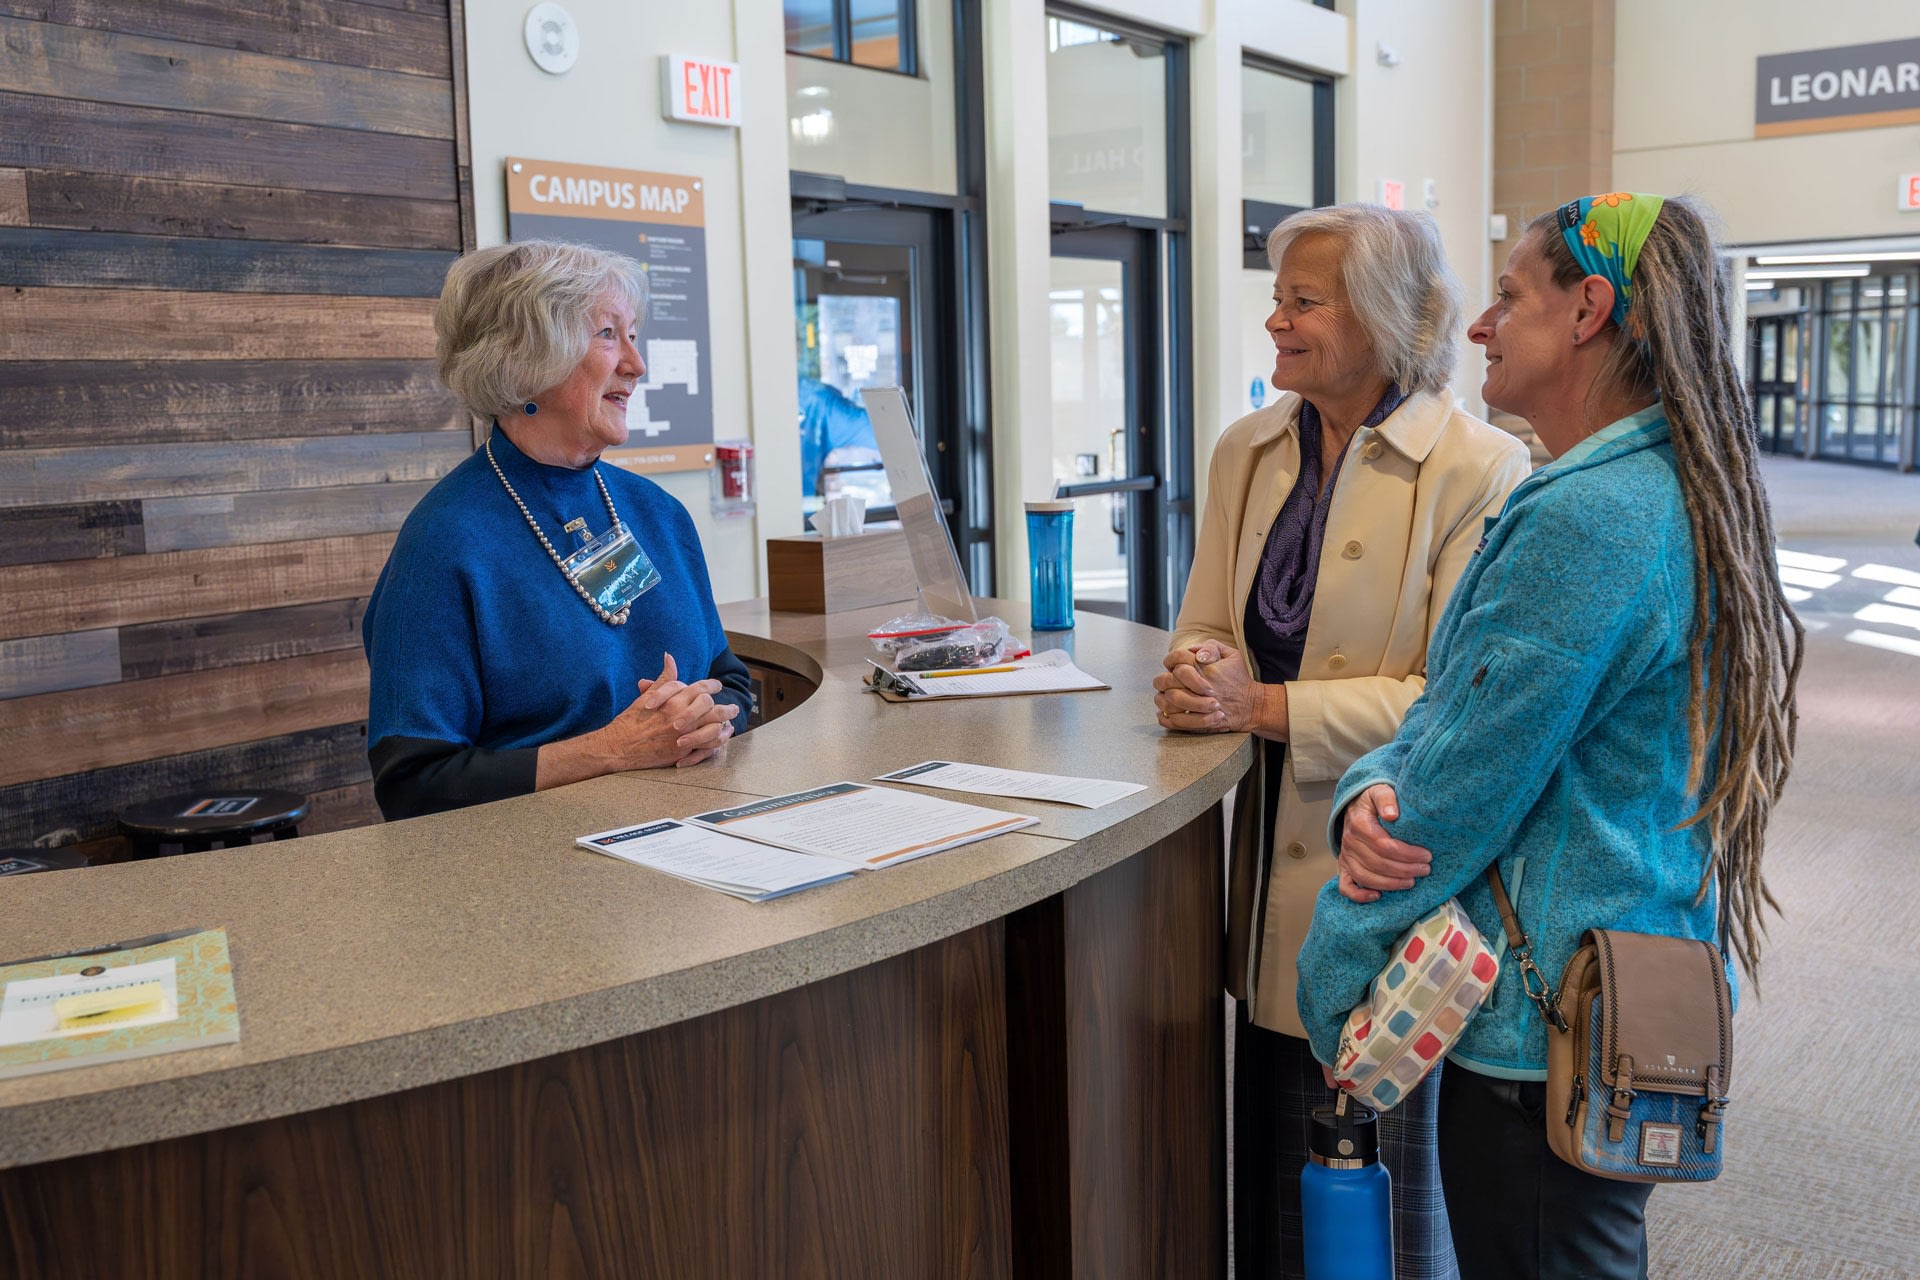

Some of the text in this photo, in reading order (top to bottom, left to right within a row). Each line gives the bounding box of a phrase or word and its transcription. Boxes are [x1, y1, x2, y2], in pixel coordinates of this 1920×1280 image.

[683, 60, 731, 120] EXIT
[1769, 61, 1920, 106] LEONAR
[529, 173, 690, 214] CAMPUS MAP
